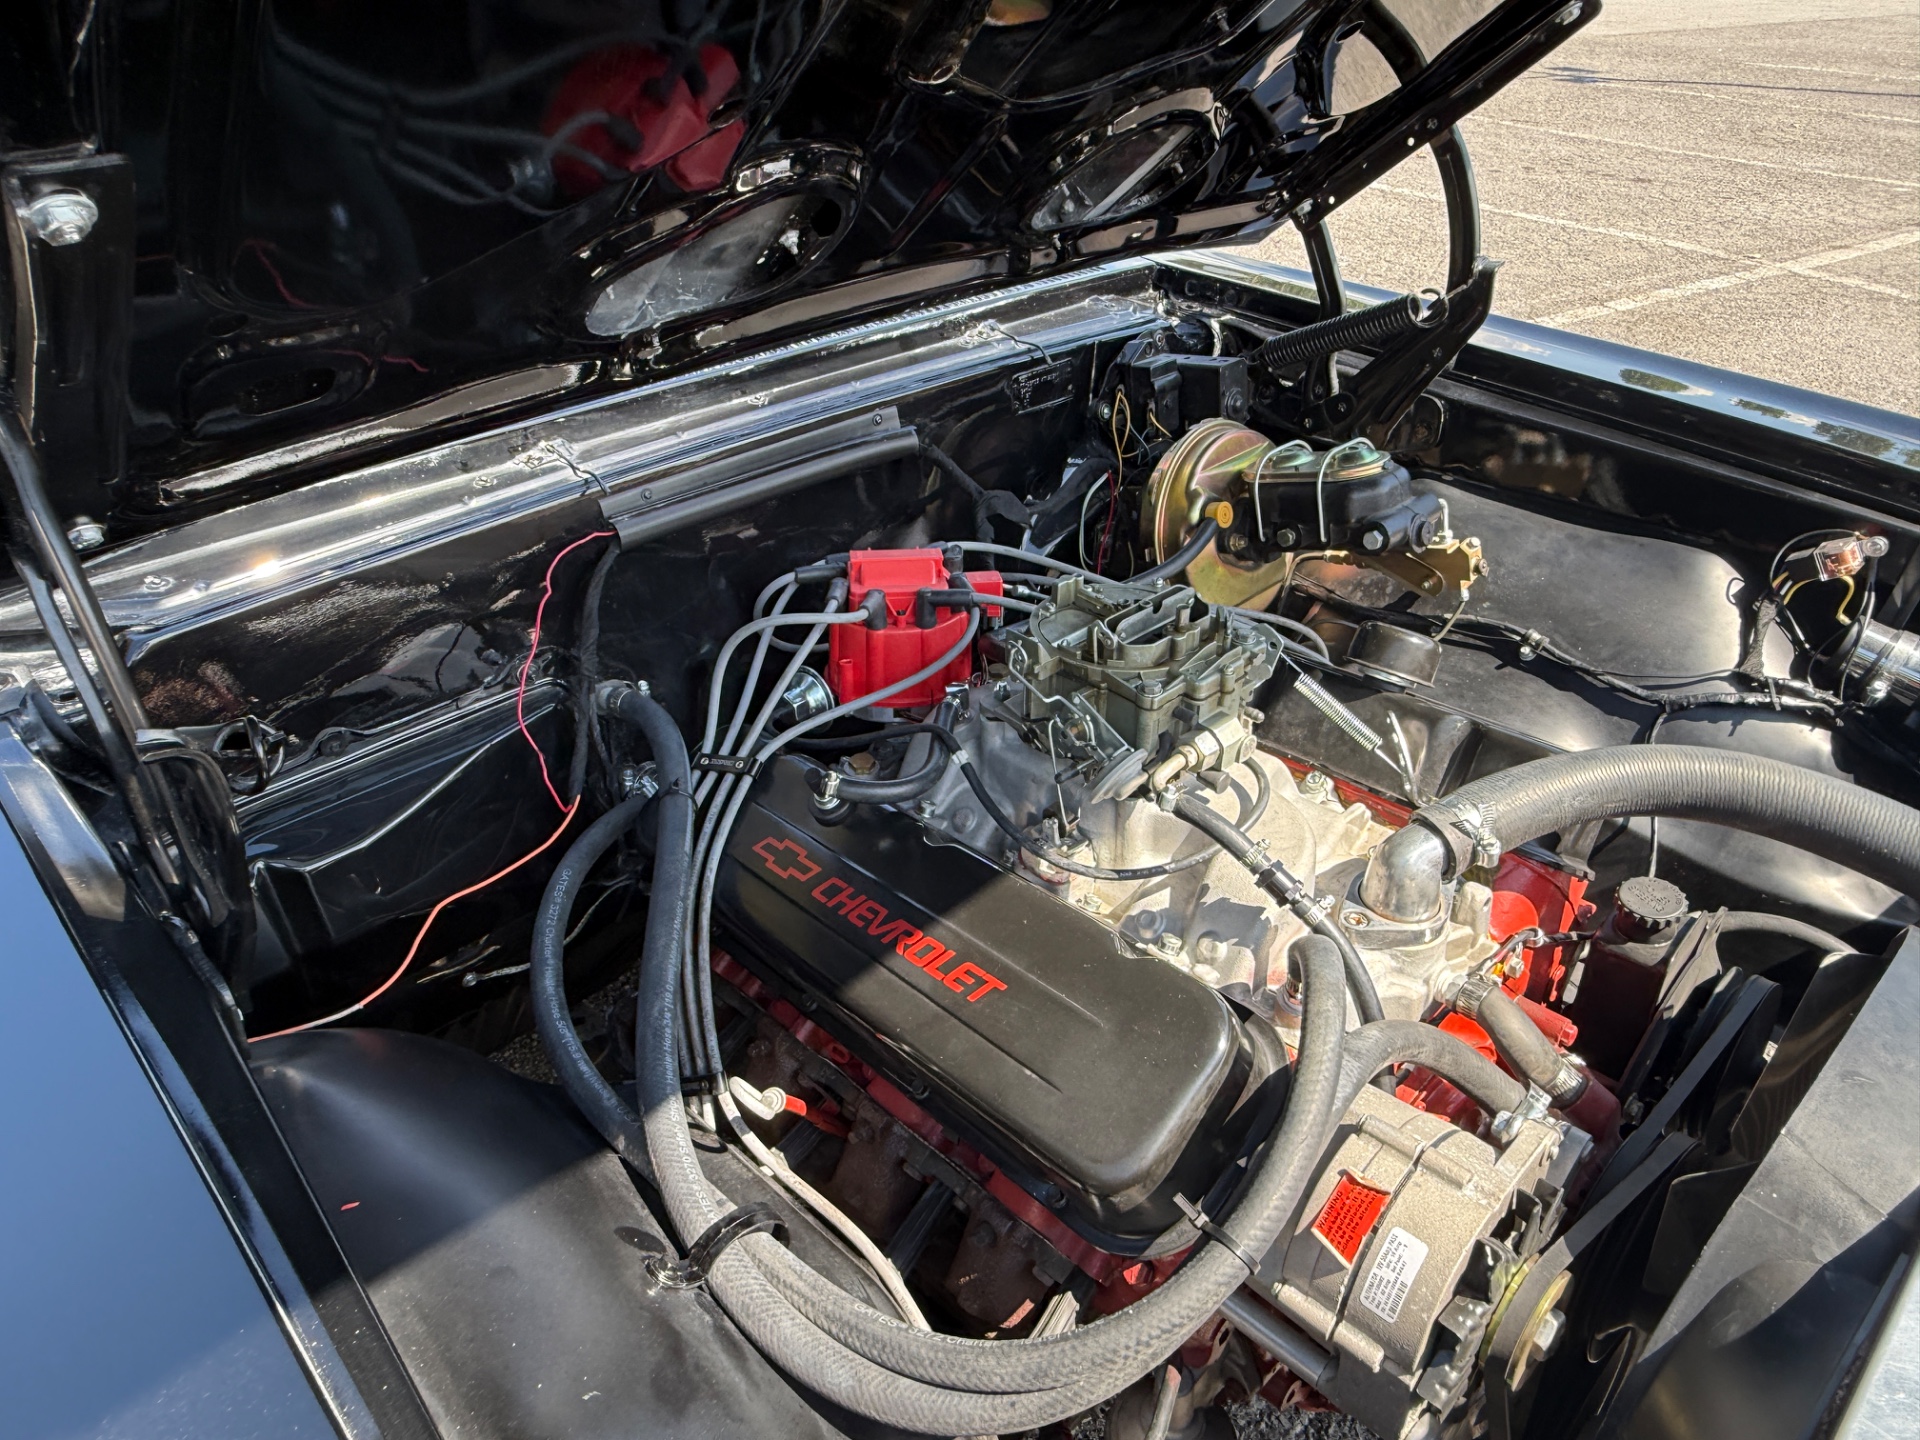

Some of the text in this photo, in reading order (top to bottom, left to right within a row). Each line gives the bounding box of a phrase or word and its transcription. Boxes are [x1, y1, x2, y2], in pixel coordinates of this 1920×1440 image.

[545, 903, 560, 926] 3272
[671, 900, 686, 931] Mexico
[811, 877, 1008, 1002] CHEVROLET
[547, 995, 563, 1019] Hose
[663, 1026, 672, 1050] Hose
[672, 1123, 690, 1155] Safety
[681, 1154, 698, 1182] 3270
[1316, 1189, 1343, 1229] WARNING
[1345, 1198, 1365, 1229] replaced
[1350, 1220, 1359, 1233] the
